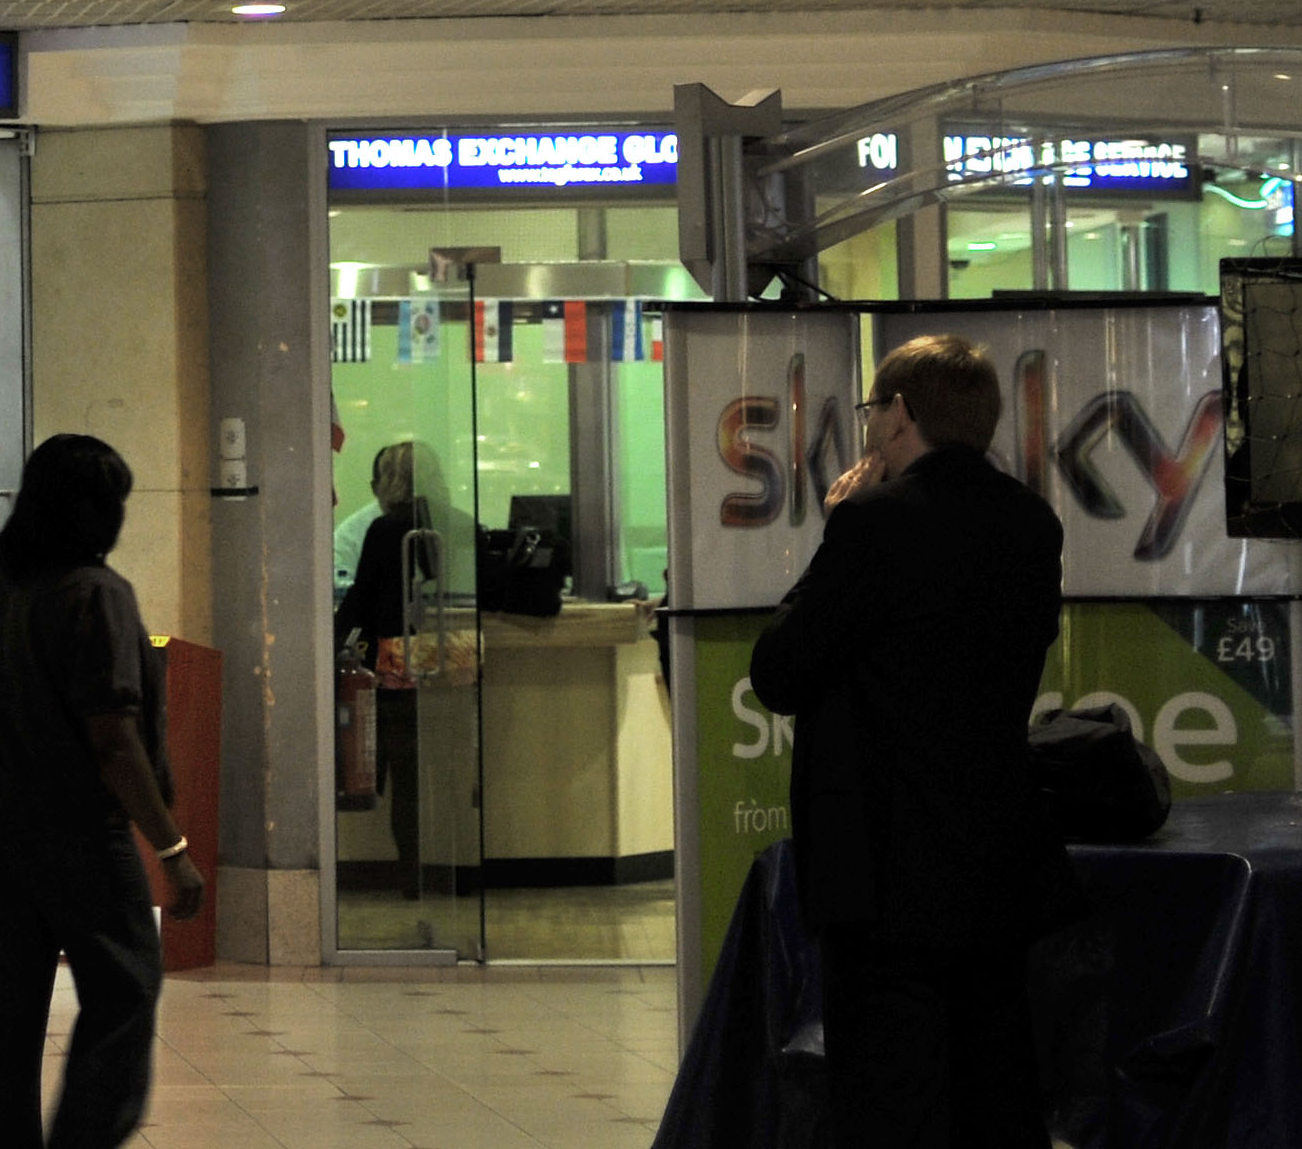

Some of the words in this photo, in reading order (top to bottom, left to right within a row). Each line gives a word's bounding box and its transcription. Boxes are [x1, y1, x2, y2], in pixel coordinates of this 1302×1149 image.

[329, 138, 453, 168] THOMAS
[458, 135, 618, 167] EXCHANGE
[1013, 349, 1224, 561] ky
[734, 800, 788, 834] from
